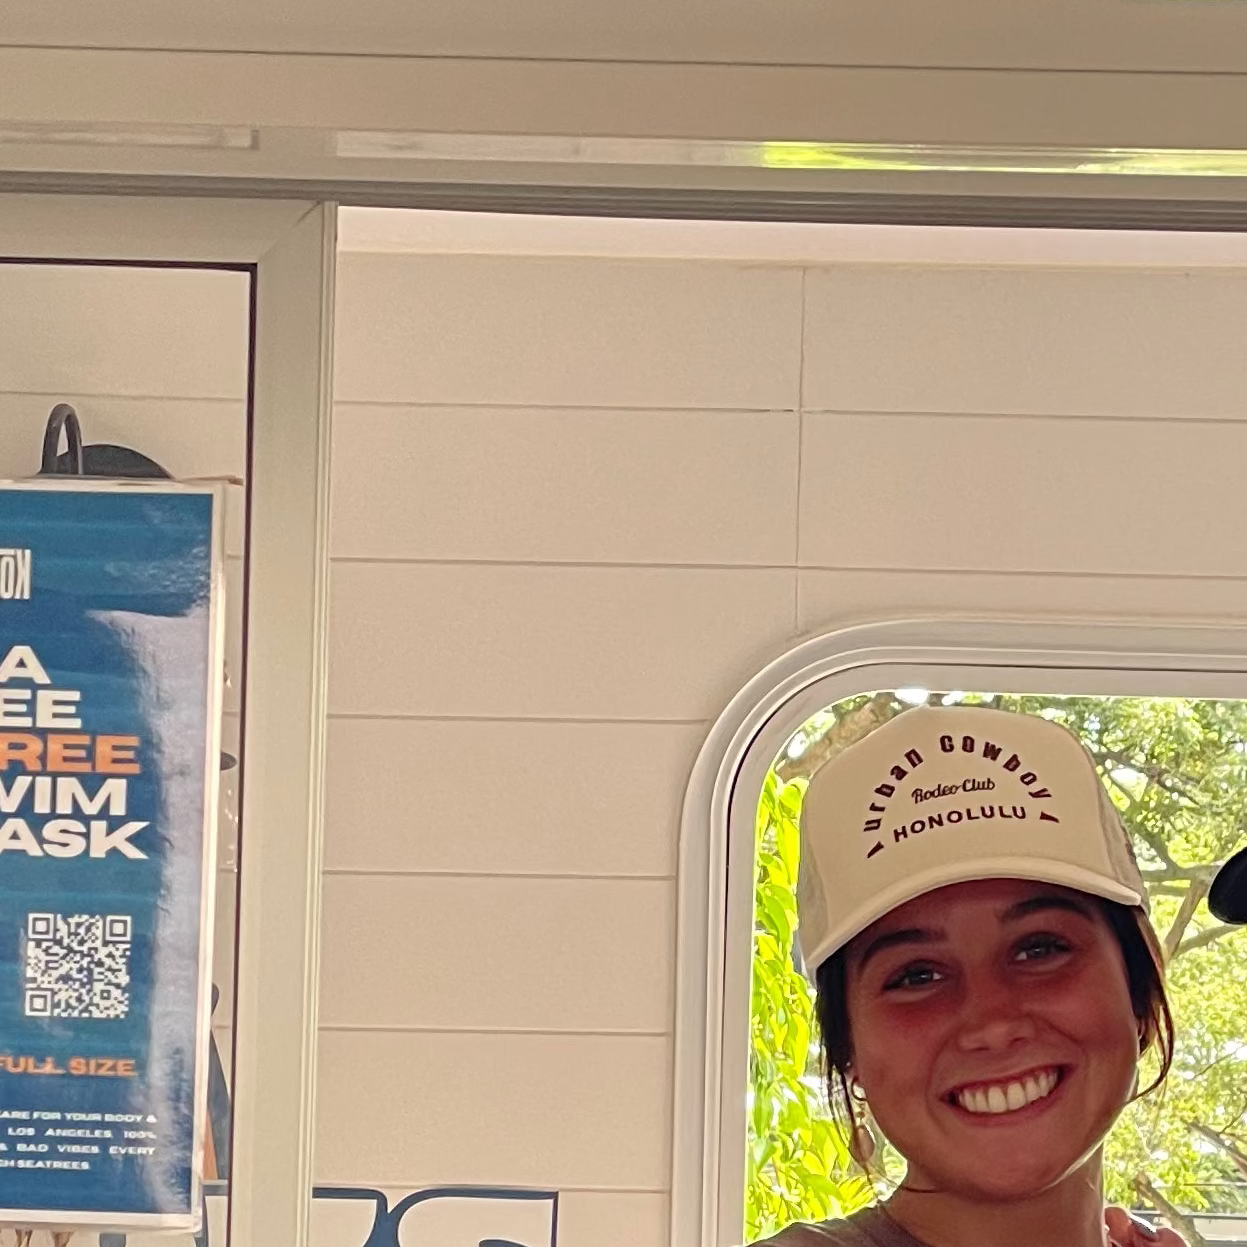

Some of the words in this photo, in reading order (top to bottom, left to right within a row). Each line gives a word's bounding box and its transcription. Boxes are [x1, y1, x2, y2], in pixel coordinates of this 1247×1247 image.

[911, 783, 961, 805] Rodeo
[961, 777, 996, 793] Club
[893, 804, 1027, 843] HONOLULU
[69, 1056, 138, 1076] SIZE
[33, 1111, 62, 1121] FOR
[64, 1113, 101, 1122] YOUR
[104, 1113, 144, 1123] BODY
[7, 1127, 36, 1137] LOS
[16, 1143, 49, 1153] BAD
[57, 1145, 101, 1154] VIBES
[108, 1146, 156, 1156] EVERY
[17, 1160, 91, 1171] SEATREES
